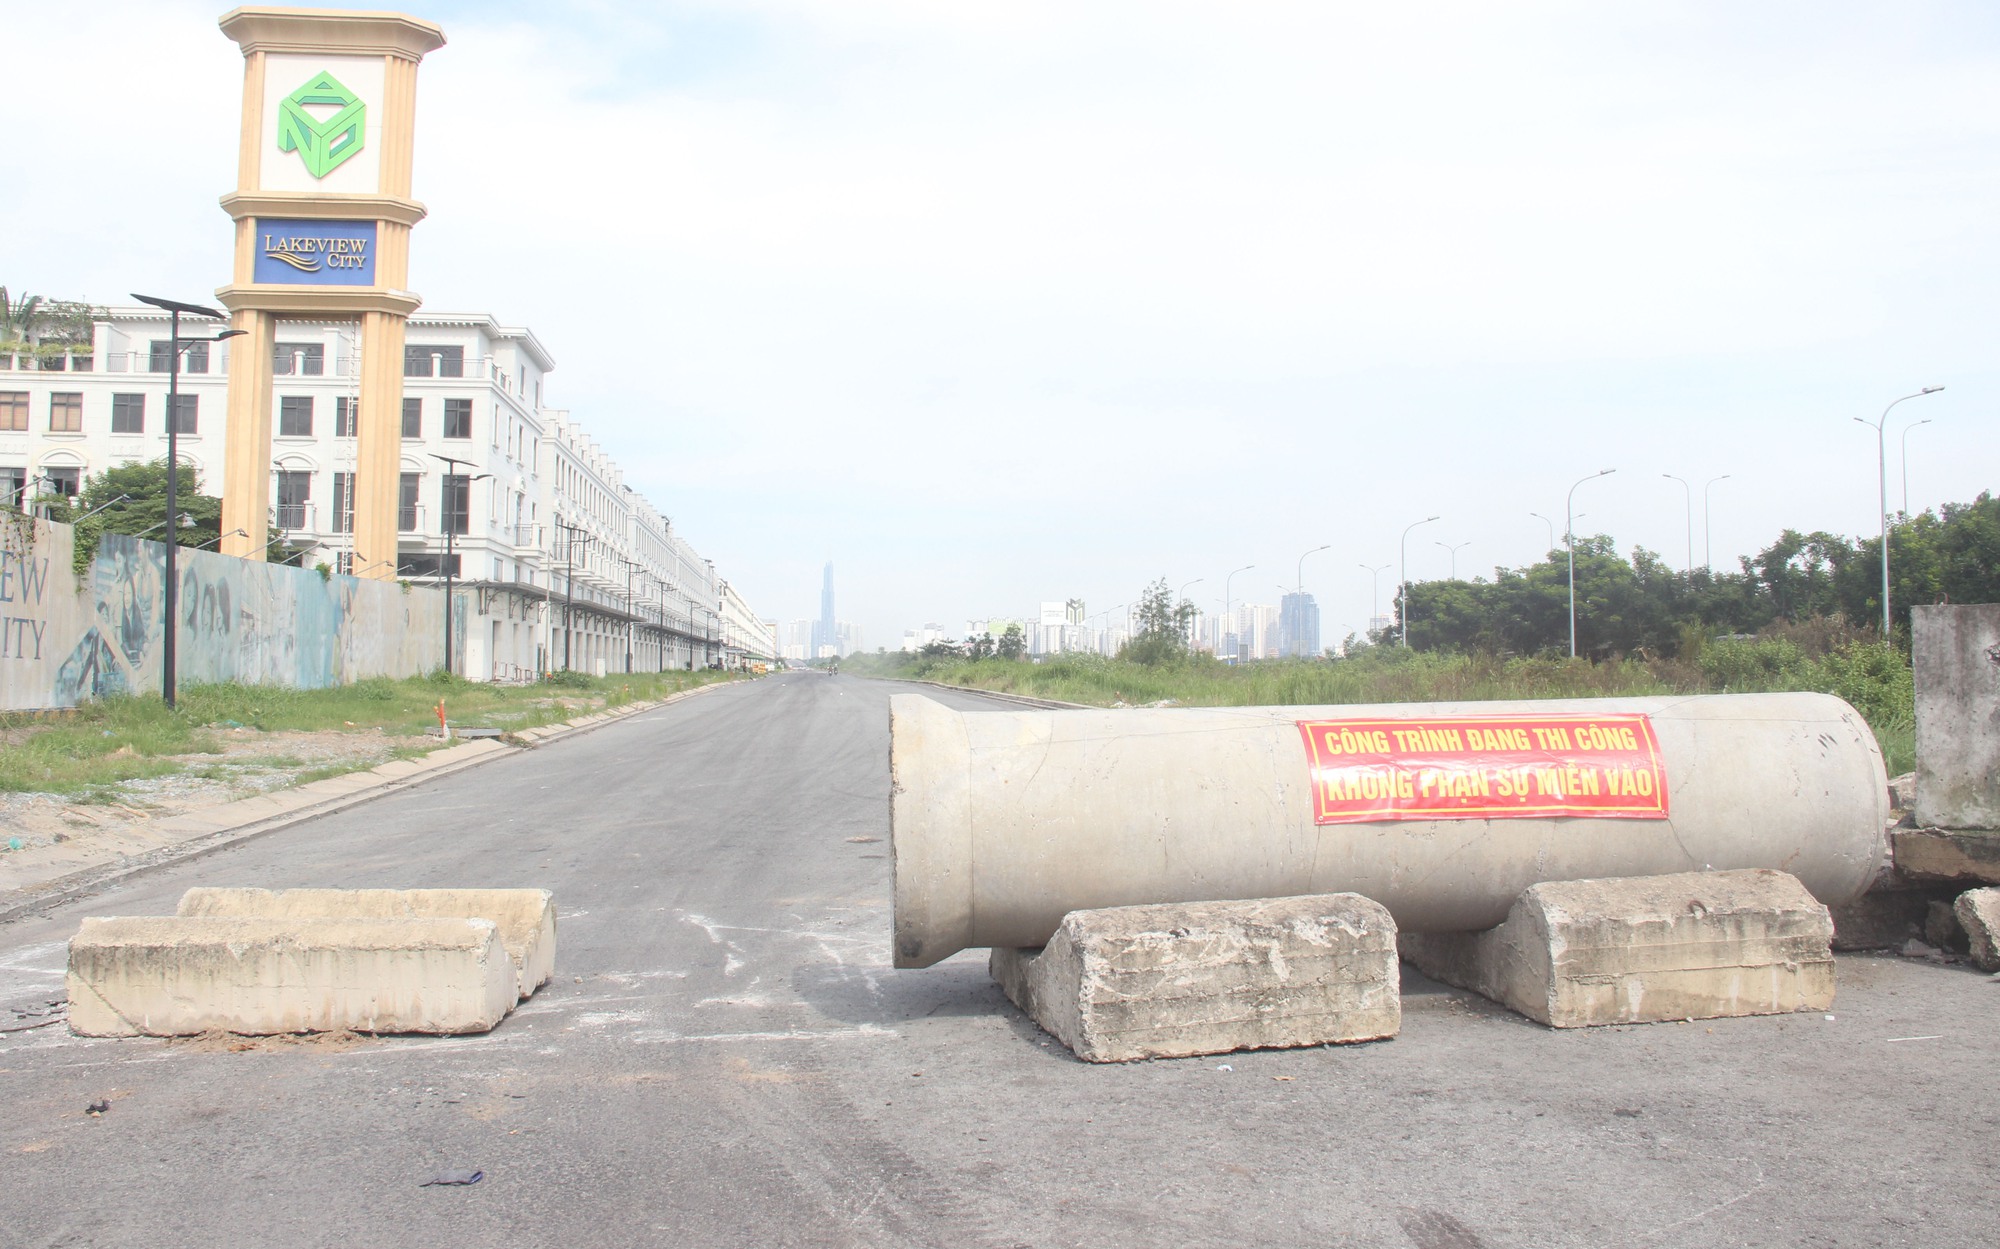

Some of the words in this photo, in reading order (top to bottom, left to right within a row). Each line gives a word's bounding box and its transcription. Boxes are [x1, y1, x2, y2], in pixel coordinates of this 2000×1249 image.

[264, 234, 367, 253] LAKEVIEW
[327, 253, 366, 268] CITY
[1324, 727, 1390, 755] CÔNG
[1392, 725, 1464, 753] TRÌNH
[1465, 728, 1532, 751] ĐANG
[1532, 727, 1572, 750] THI
[1574, 723, 1638, 750] CÔNG
[1603, 763, 1653, 797] VÀO
